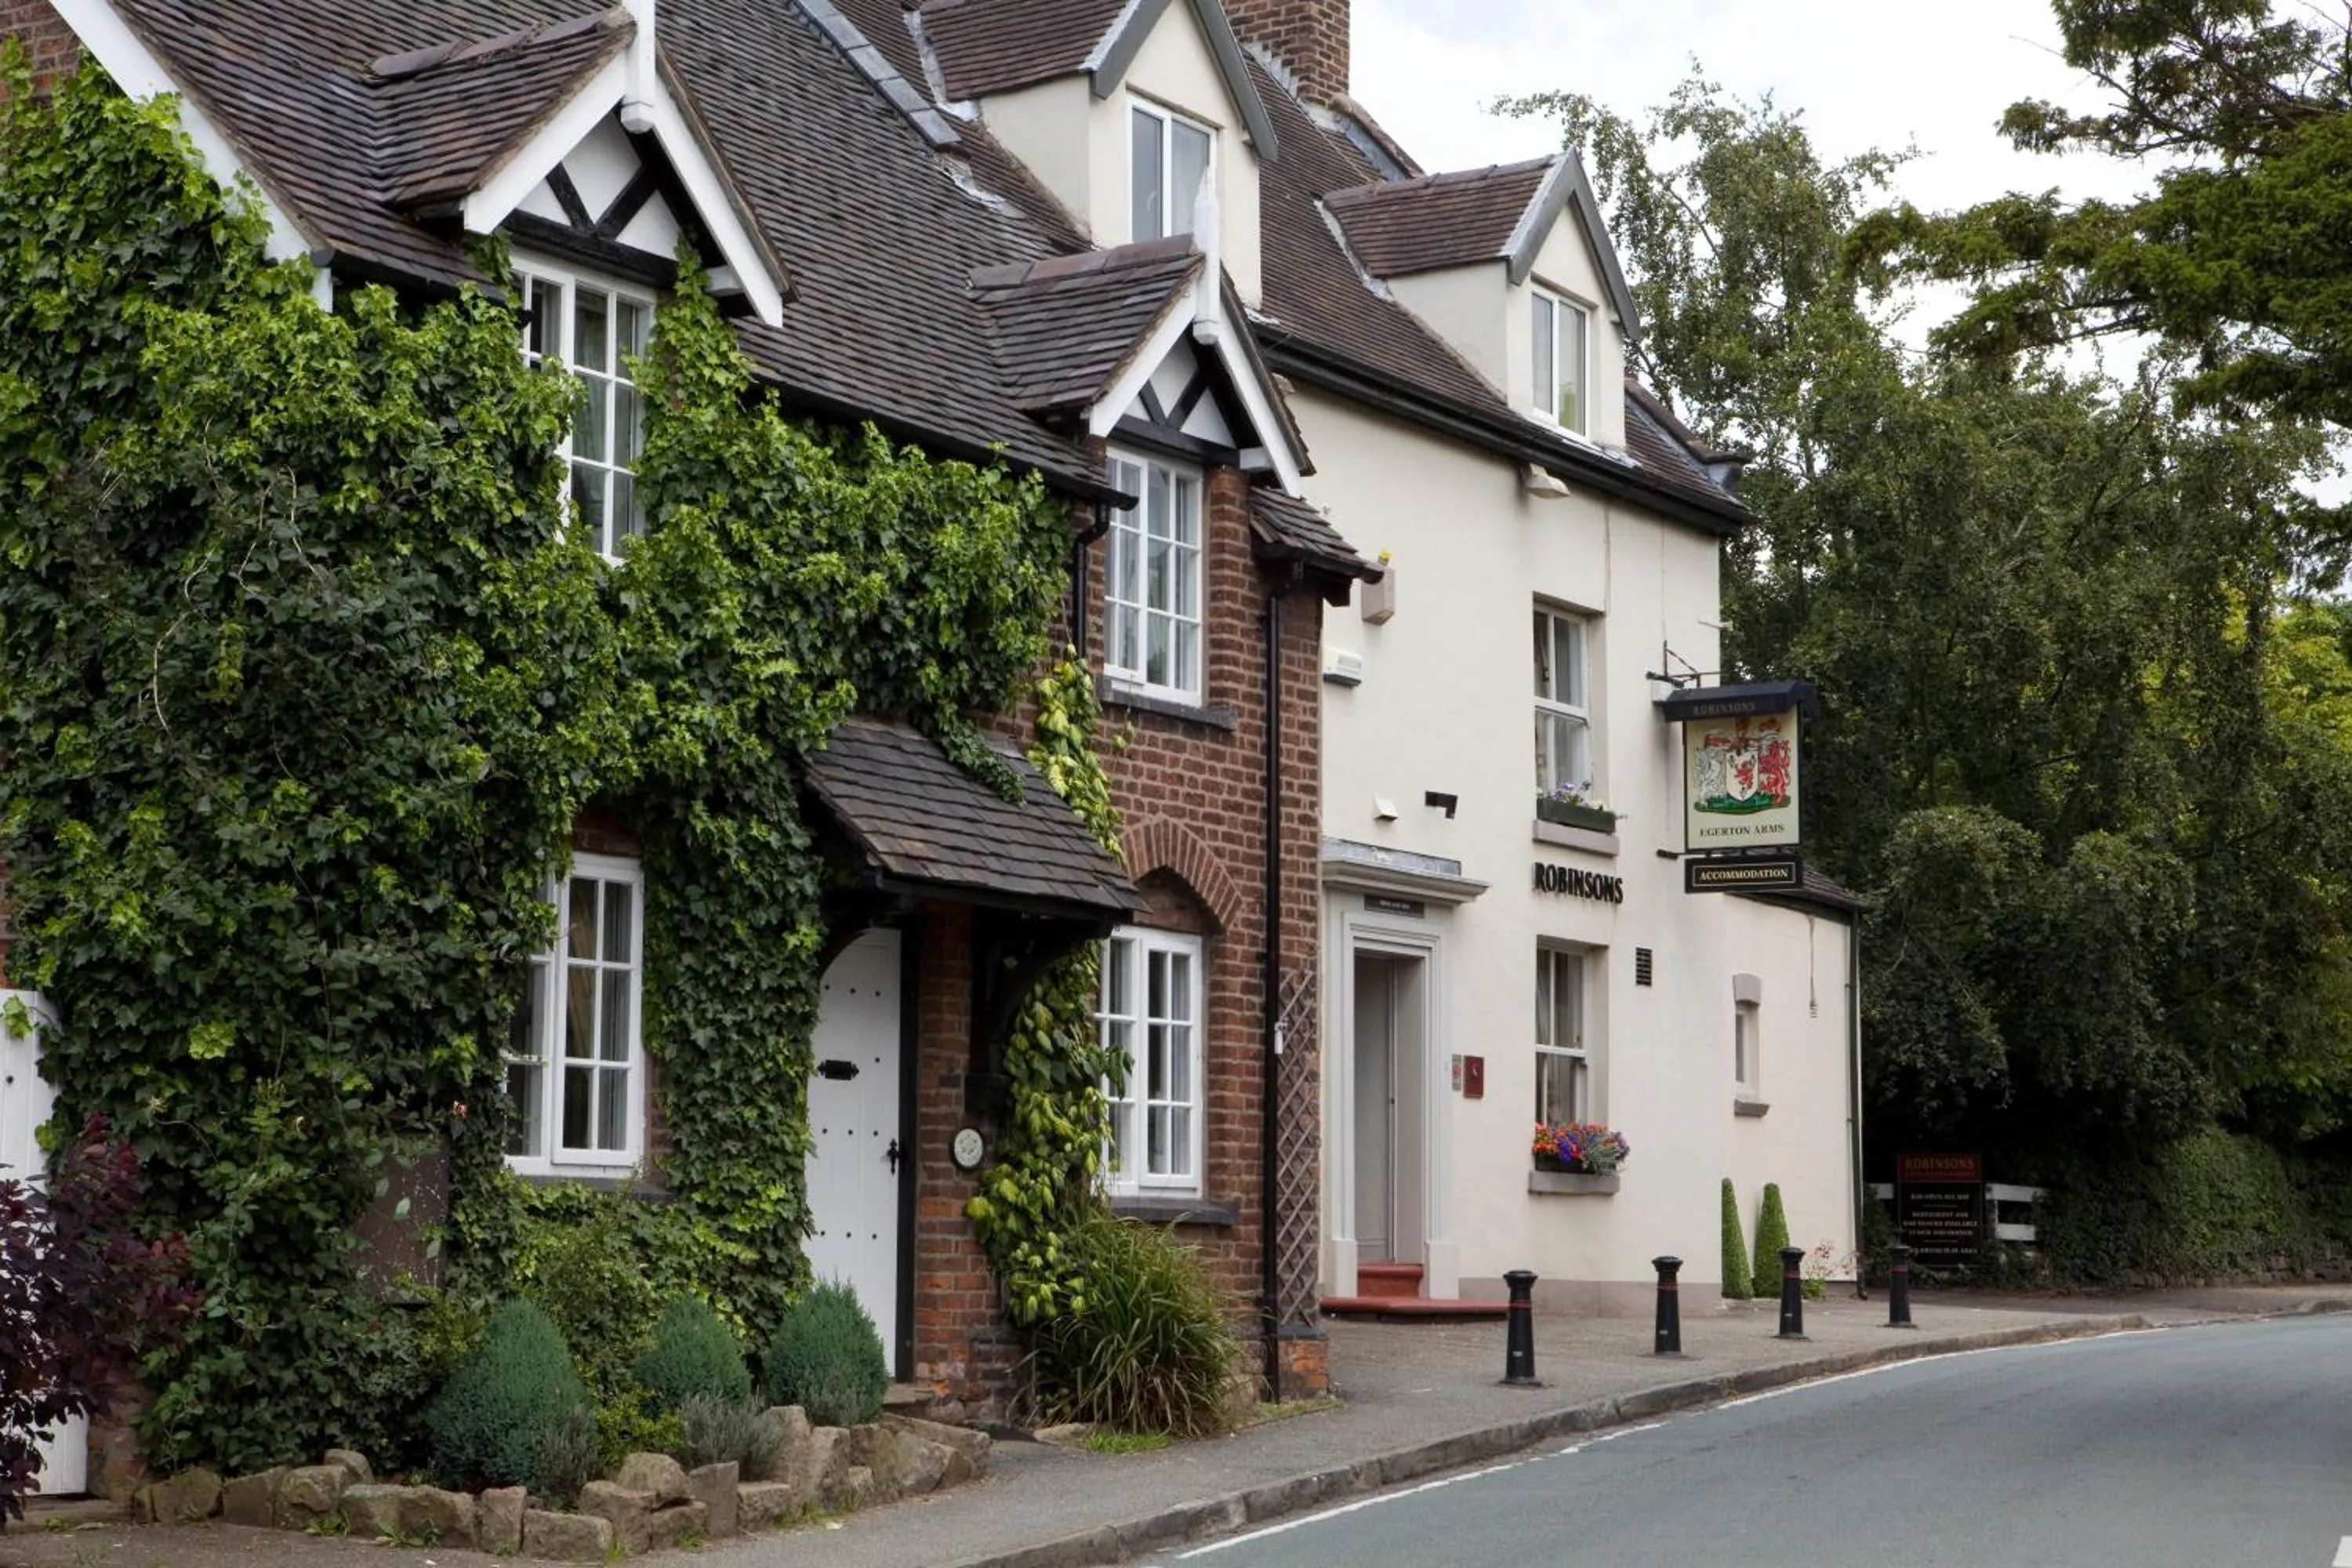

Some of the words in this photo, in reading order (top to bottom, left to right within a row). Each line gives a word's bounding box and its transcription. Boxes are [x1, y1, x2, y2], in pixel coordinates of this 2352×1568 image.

[1693, 702, 1756, 717] ROBINSONS
[1700, 827, 1751, 837] EGERTON
[1754, 824, 1785, 834] ARMS
[1700, 868, 1789, 880] ACCOMMODATION
[1534, 862, 1624, 904] ROBINSONS
[1905, 1156, 1974, 1170] ROBINSONS
